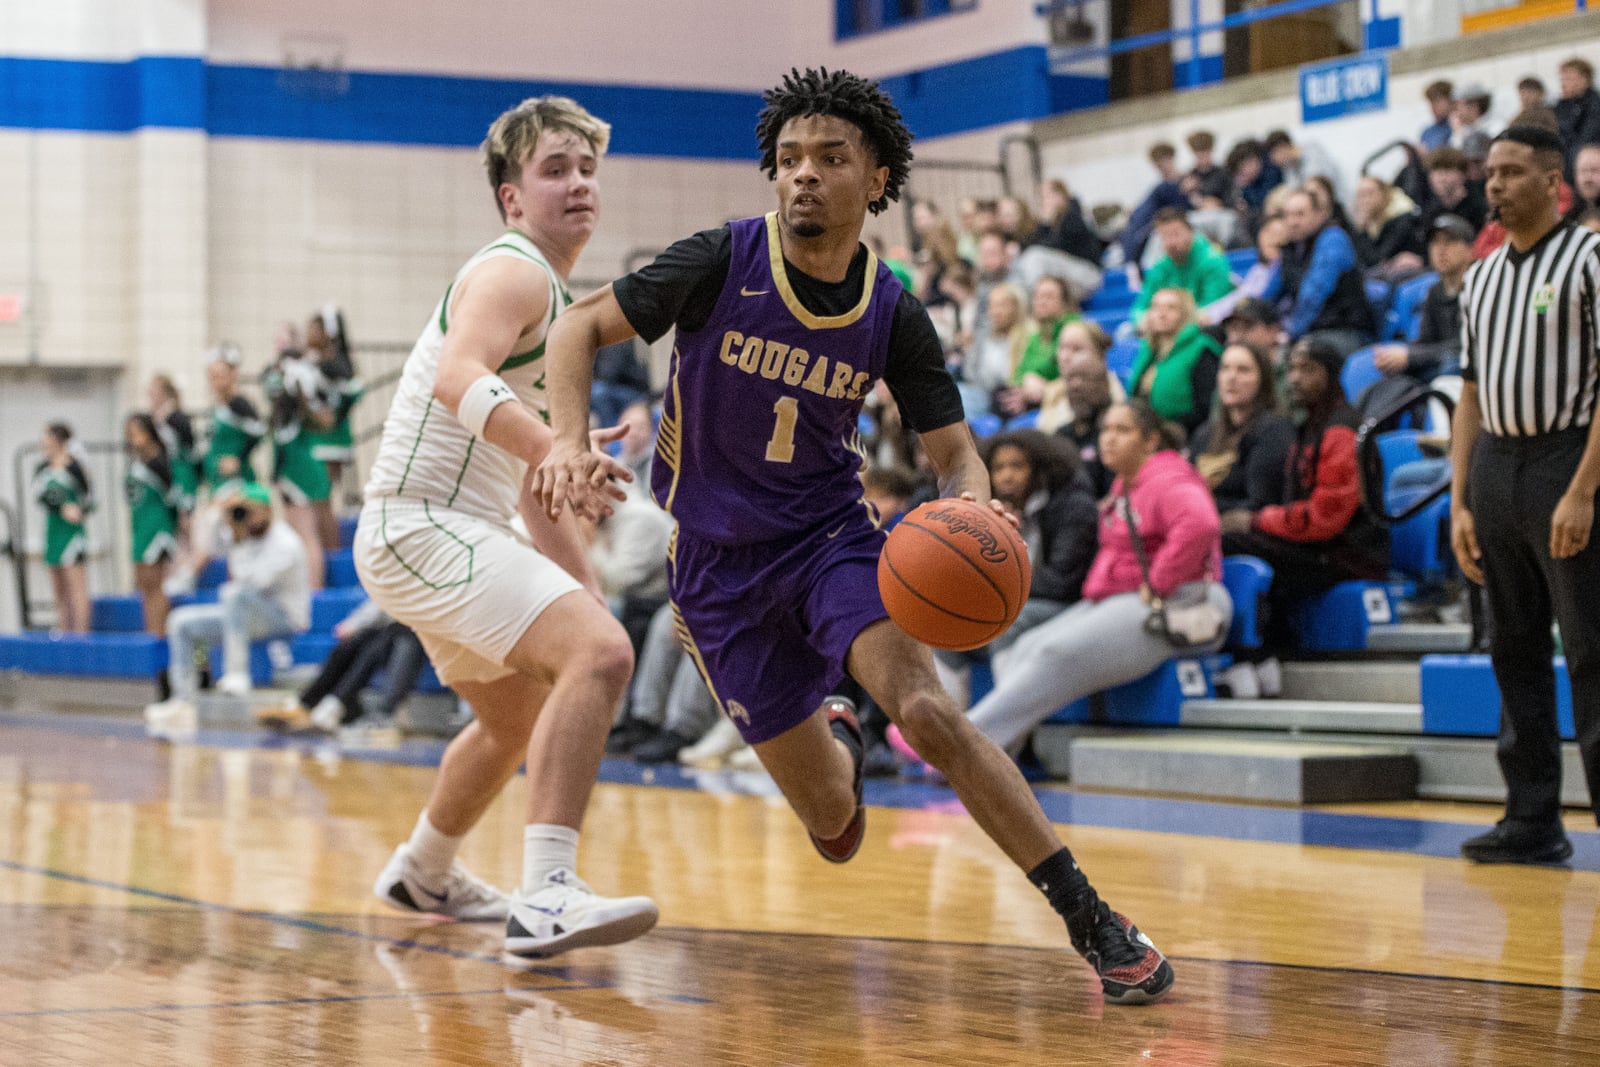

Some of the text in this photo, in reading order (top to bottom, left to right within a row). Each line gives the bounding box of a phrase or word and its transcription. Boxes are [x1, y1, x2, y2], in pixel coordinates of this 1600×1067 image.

[719, 330, 870, 400] COUGARS
[765, 396, 799, 463] 1
[924, 507, 1008, 563] Rawlings
